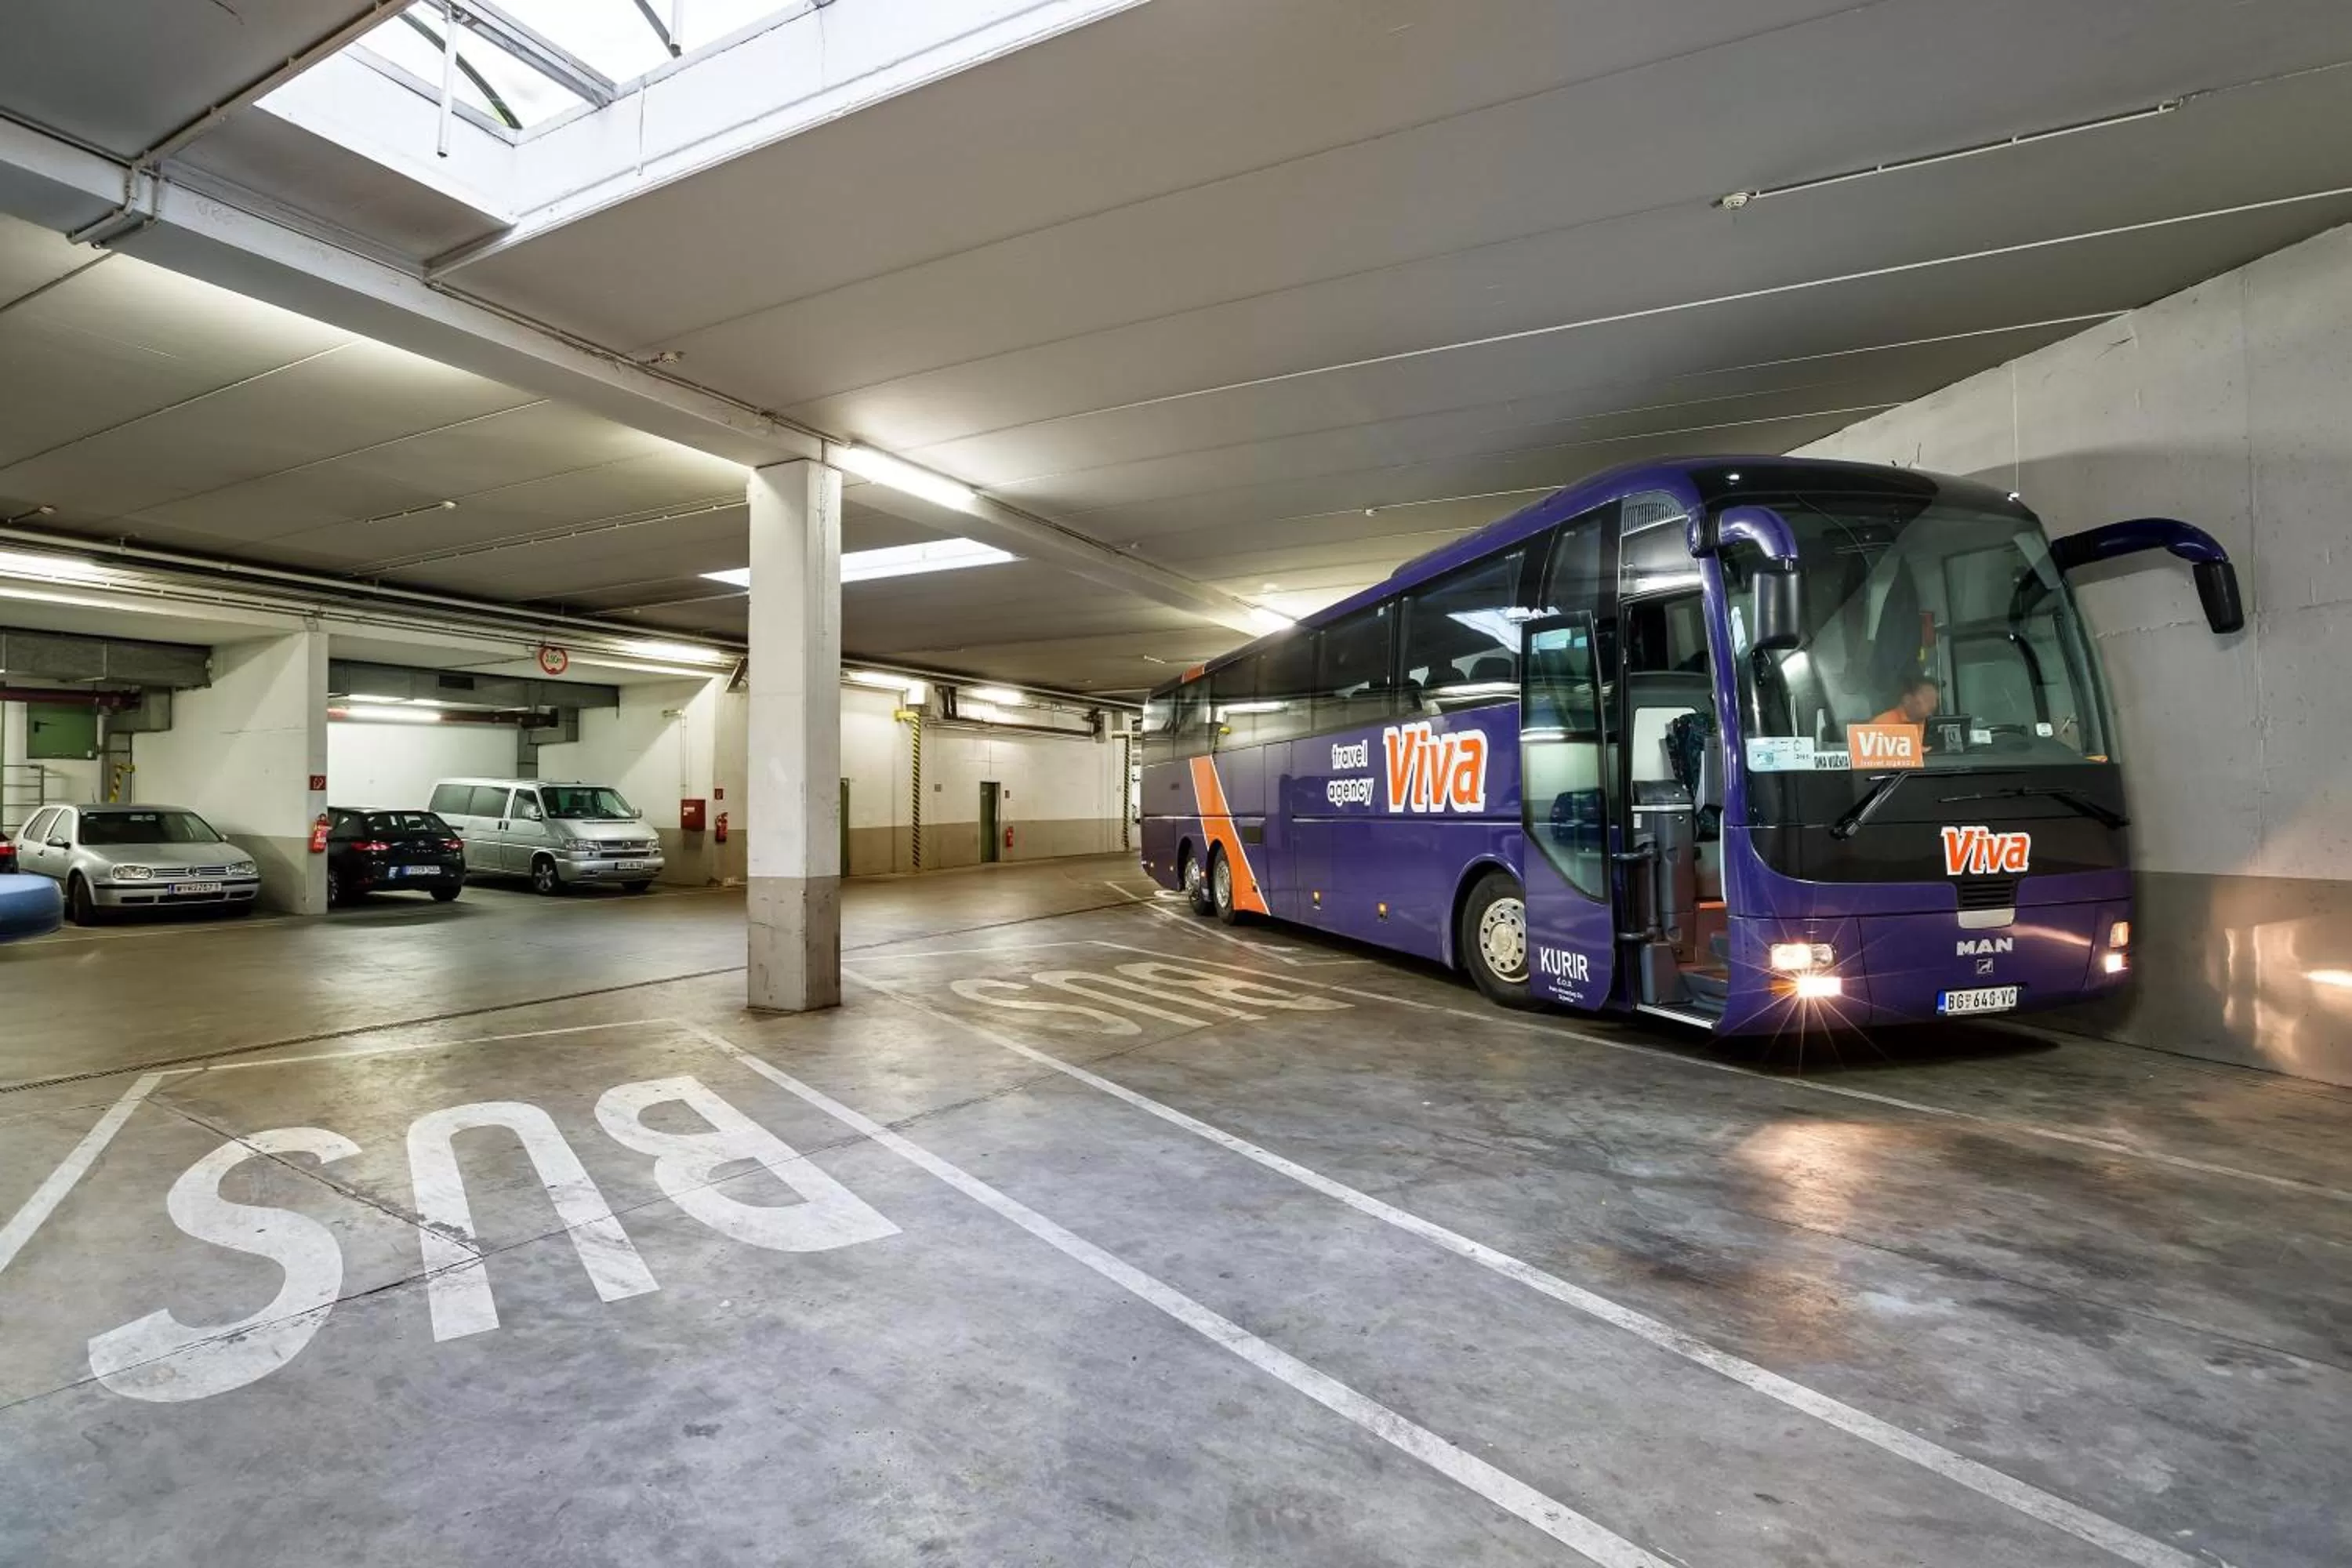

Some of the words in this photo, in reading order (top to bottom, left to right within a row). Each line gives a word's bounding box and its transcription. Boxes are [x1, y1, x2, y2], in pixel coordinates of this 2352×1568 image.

[1332, 739, 1368, 770] travel
[1857, 731, 1911, 757] Viva
[1382, 720, 1488, 813] Viva
[1327, 777, 1374, 808] agency
[1940, 826, 2031, 876] Viva
[1956, 937, 2014, 956] MAN
[1540, 946, 1590, 982] KURIR
[949, 961, 1356, 1036] BUS
[1948, 993, 1965, 1011] BG
[87, 1075, 903, 1403] BUS
